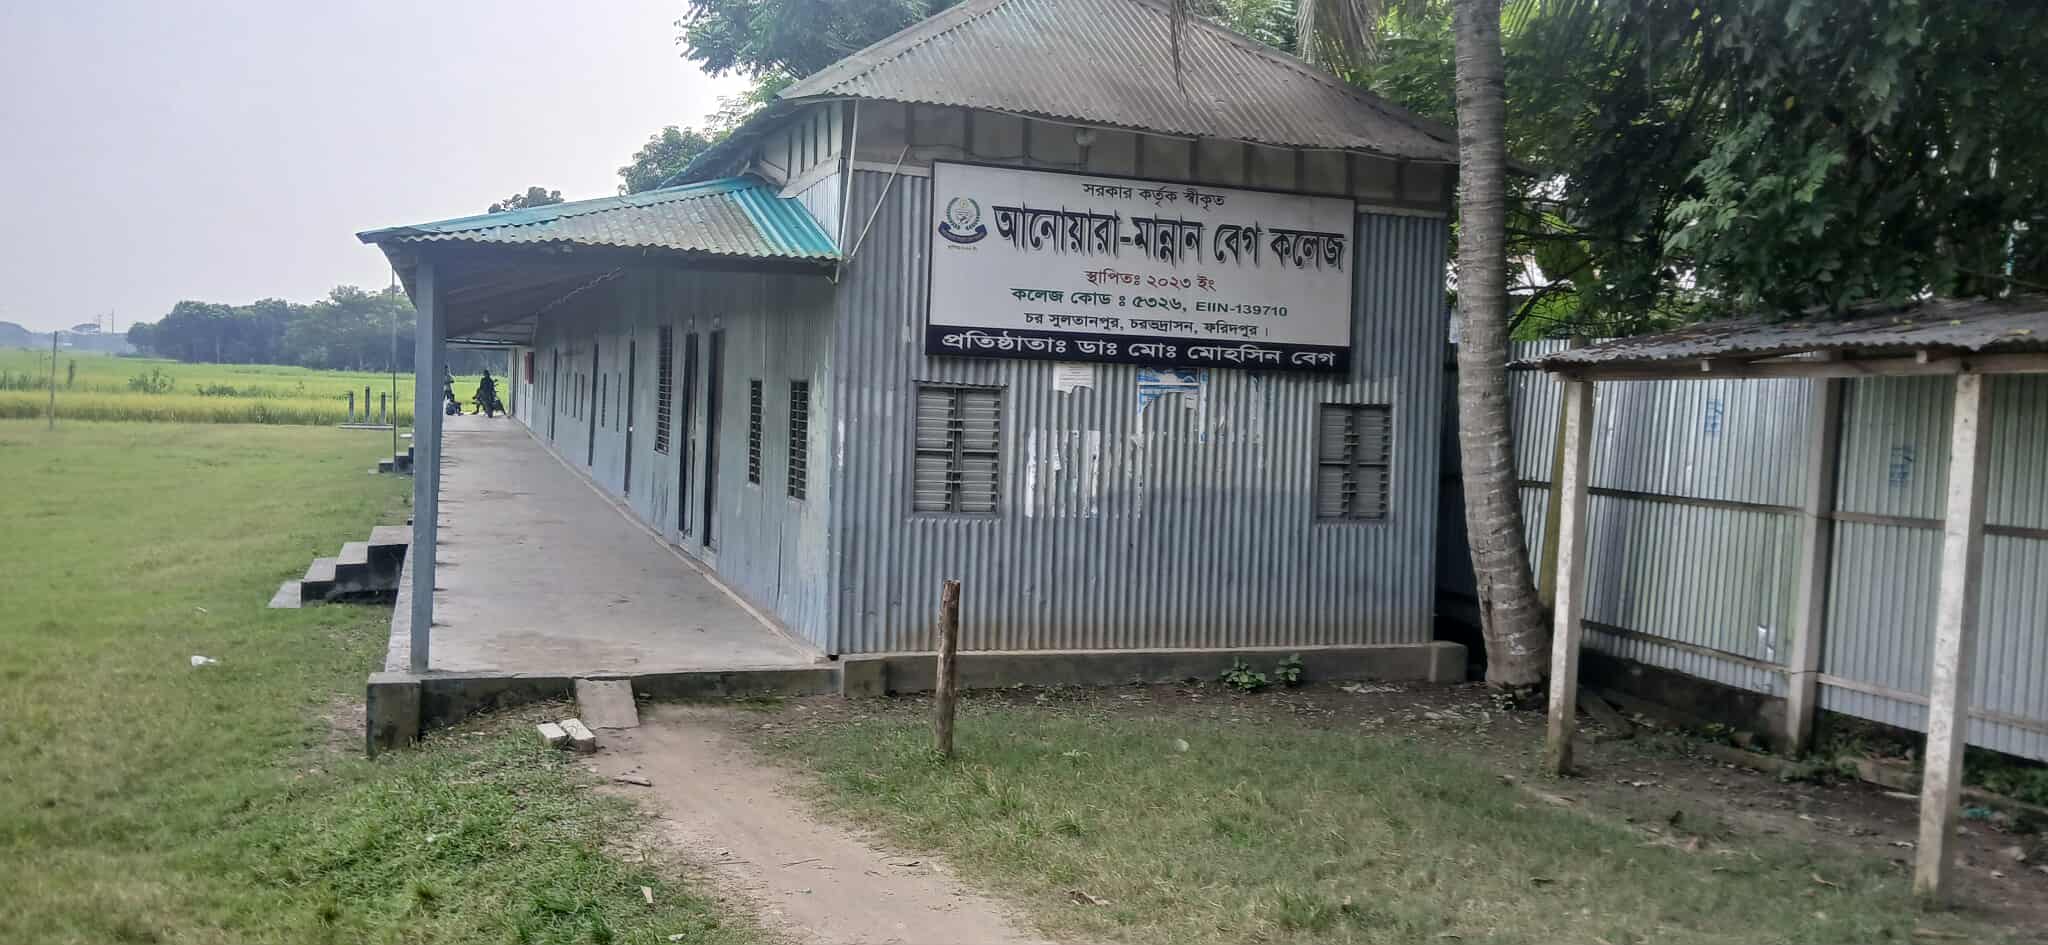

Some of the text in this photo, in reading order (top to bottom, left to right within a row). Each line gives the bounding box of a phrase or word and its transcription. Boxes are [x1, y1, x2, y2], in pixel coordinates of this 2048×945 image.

[1081, 183, 1226, 212] সরকার কর্তৃক স্বীকৃত
[992, 202, 1346, 271] আনোয়ারা-মান্নান বেগ কলেজ
[1146, 275, 1192, 289] ২০২৩
[1197, 274, 1217, 292] ইং
[1009, 288, 1064, 304] কলেজ
[1071, 292, 1113, 306] কোড
[1195, 301, 1288, 317] EIIN-139710
[1024, 312, 1043, 325] চর
[1201, 319, 1259, 337] ফরিদপুর
[1187, 344, 1283, 364] মোহসিন
[1291, 351, 1336, 367] বেগ
